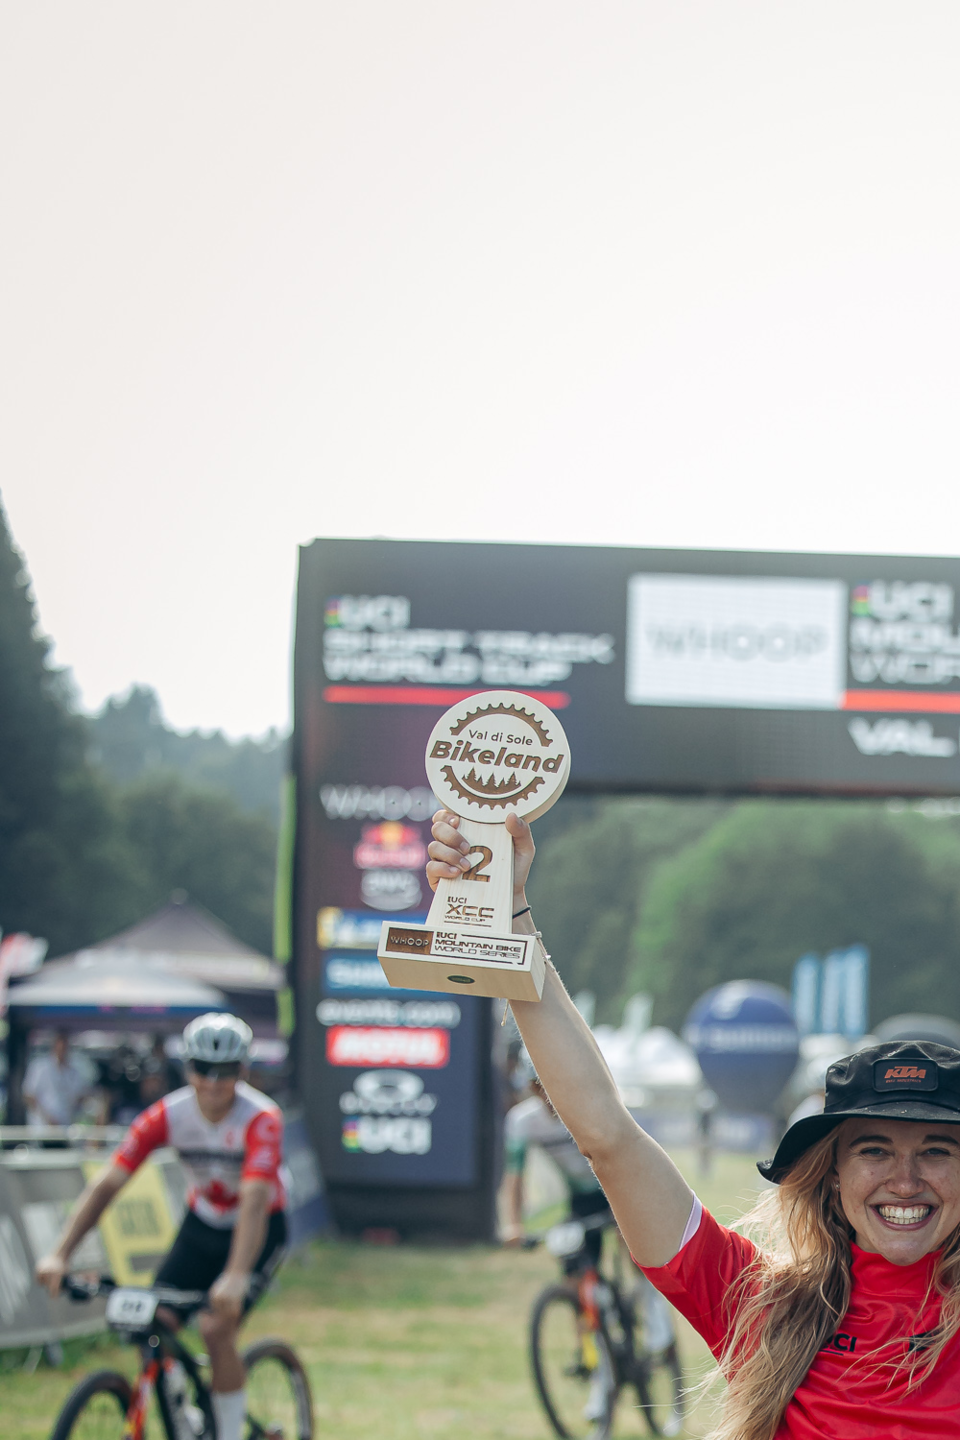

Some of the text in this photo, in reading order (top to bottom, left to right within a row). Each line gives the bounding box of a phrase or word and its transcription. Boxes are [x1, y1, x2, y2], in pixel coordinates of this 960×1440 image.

[469, 729, 533, 746] Val di Sole
[429, 740, 565, 773] Bikeland
[319, 787, 438, 822] WHOO
[462, 845, 493, 883] 2
[446, 904, 495, 919] XCC
[390, 936, 430, 948] WHOOP
[435, 939, 522, 953] MOUNTAIN BIKE
[434, 945, 477, 955] WORLD
[884, 1066, 927, 1079] KTM
